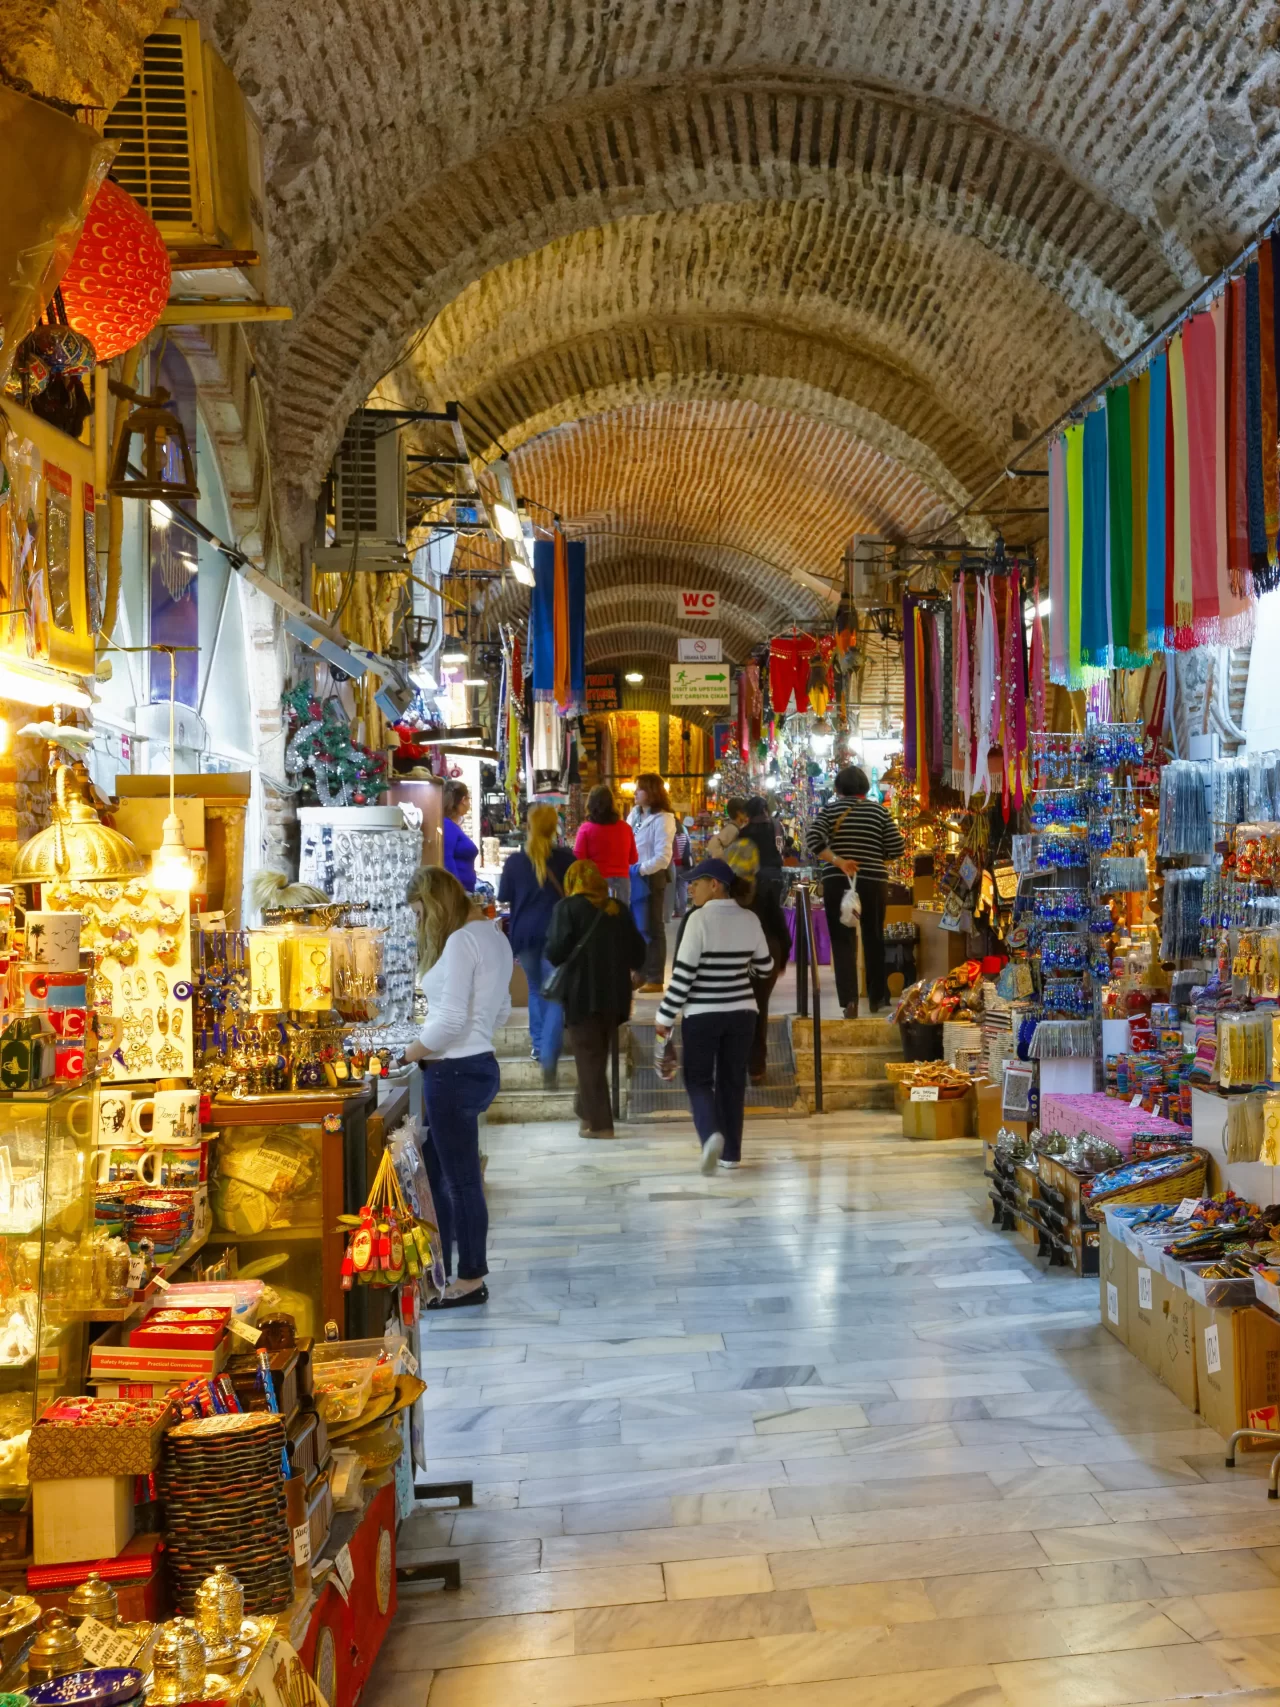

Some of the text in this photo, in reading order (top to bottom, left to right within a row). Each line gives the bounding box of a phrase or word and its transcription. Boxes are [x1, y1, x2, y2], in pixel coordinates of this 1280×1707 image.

[682, 593, 716, 608] WC
[118, 1359, 139, 1367] Hygiene
[170, 1361, 203, 1369] Convenience
